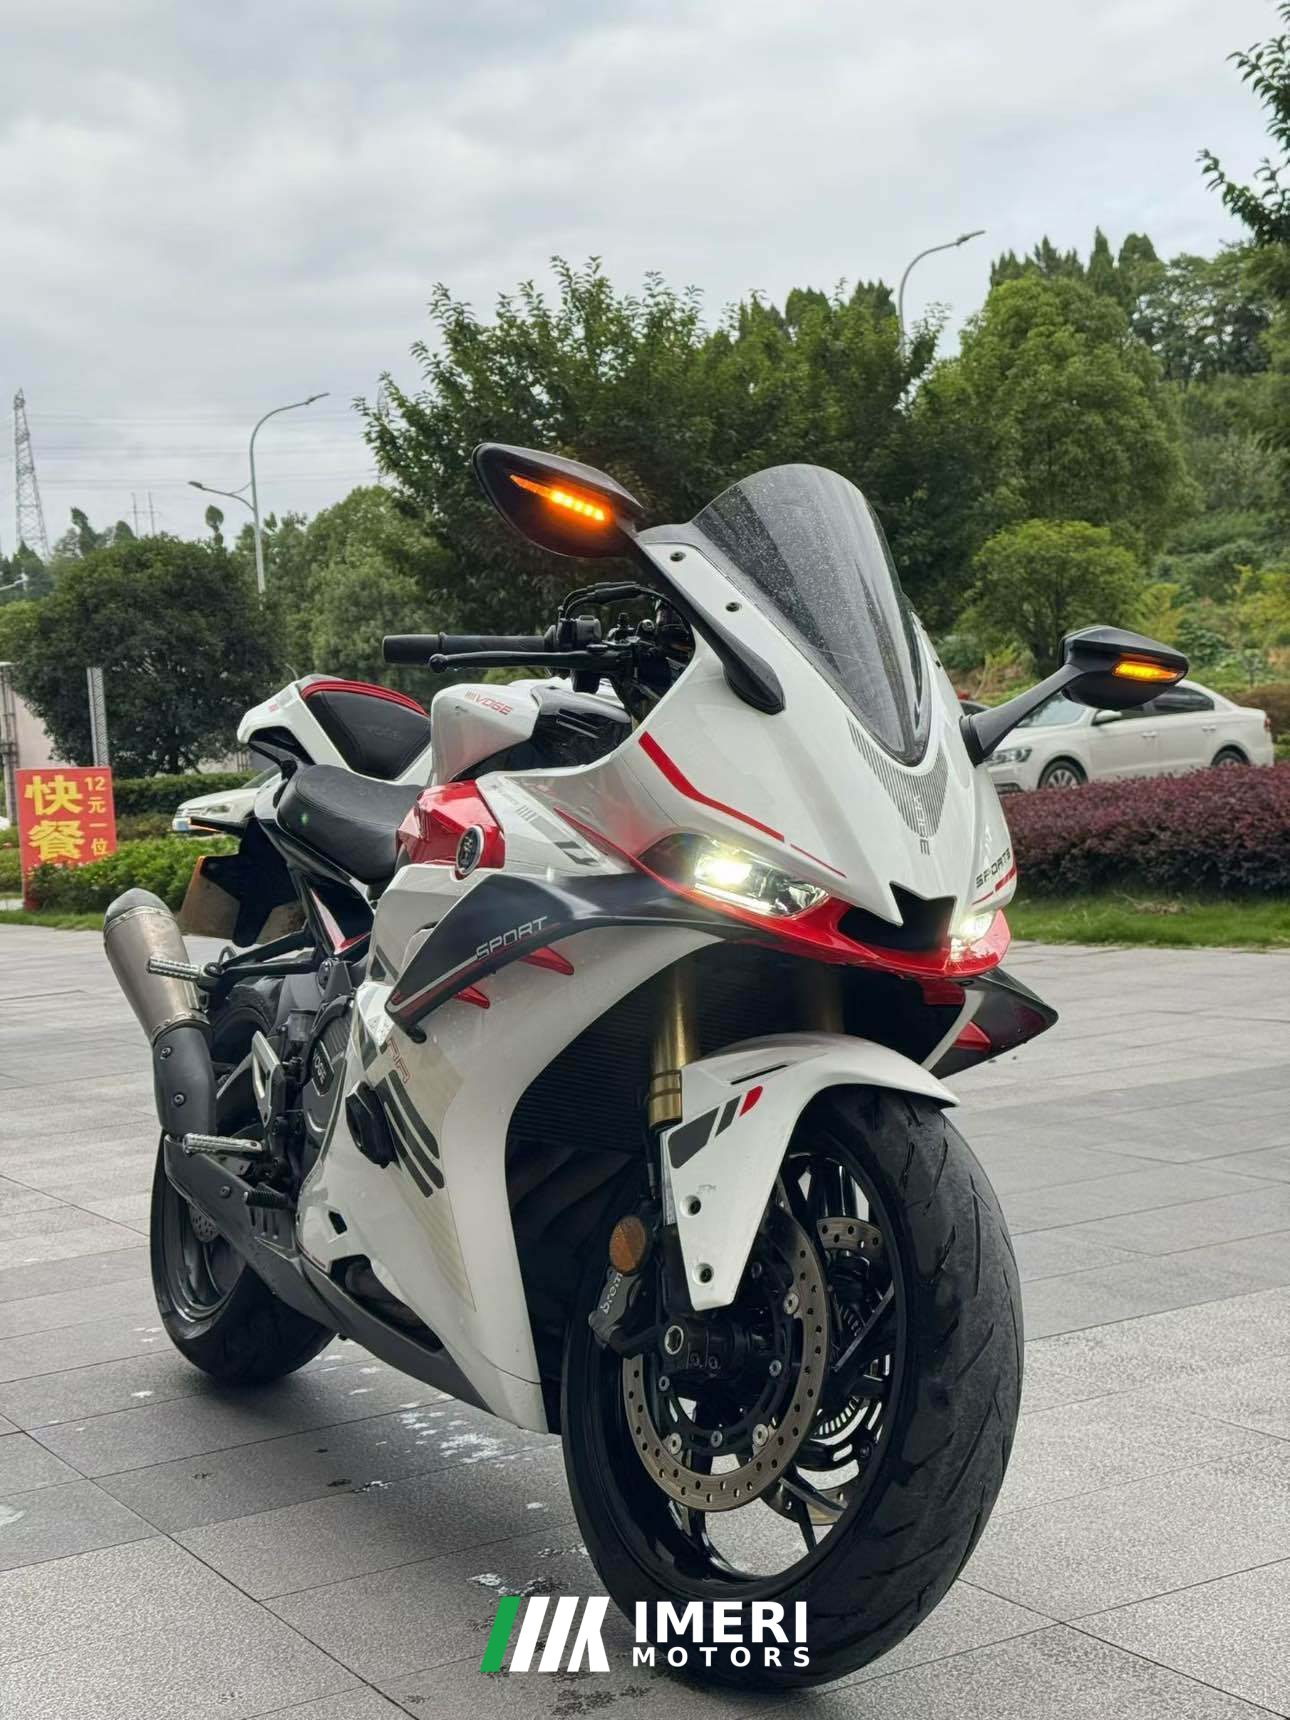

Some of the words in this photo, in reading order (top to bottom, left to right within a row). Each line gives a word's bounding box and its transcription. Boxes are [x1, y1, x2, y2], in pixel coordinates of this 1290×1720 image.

[478, 696, 513, 716] VOGE
[24, 774, 85, 861] 快餐
[84, 776, 109, 856] 12元一位
[975, 847, 1011, 889] SPORTS
[476, 915, 549, 961] SPORT
